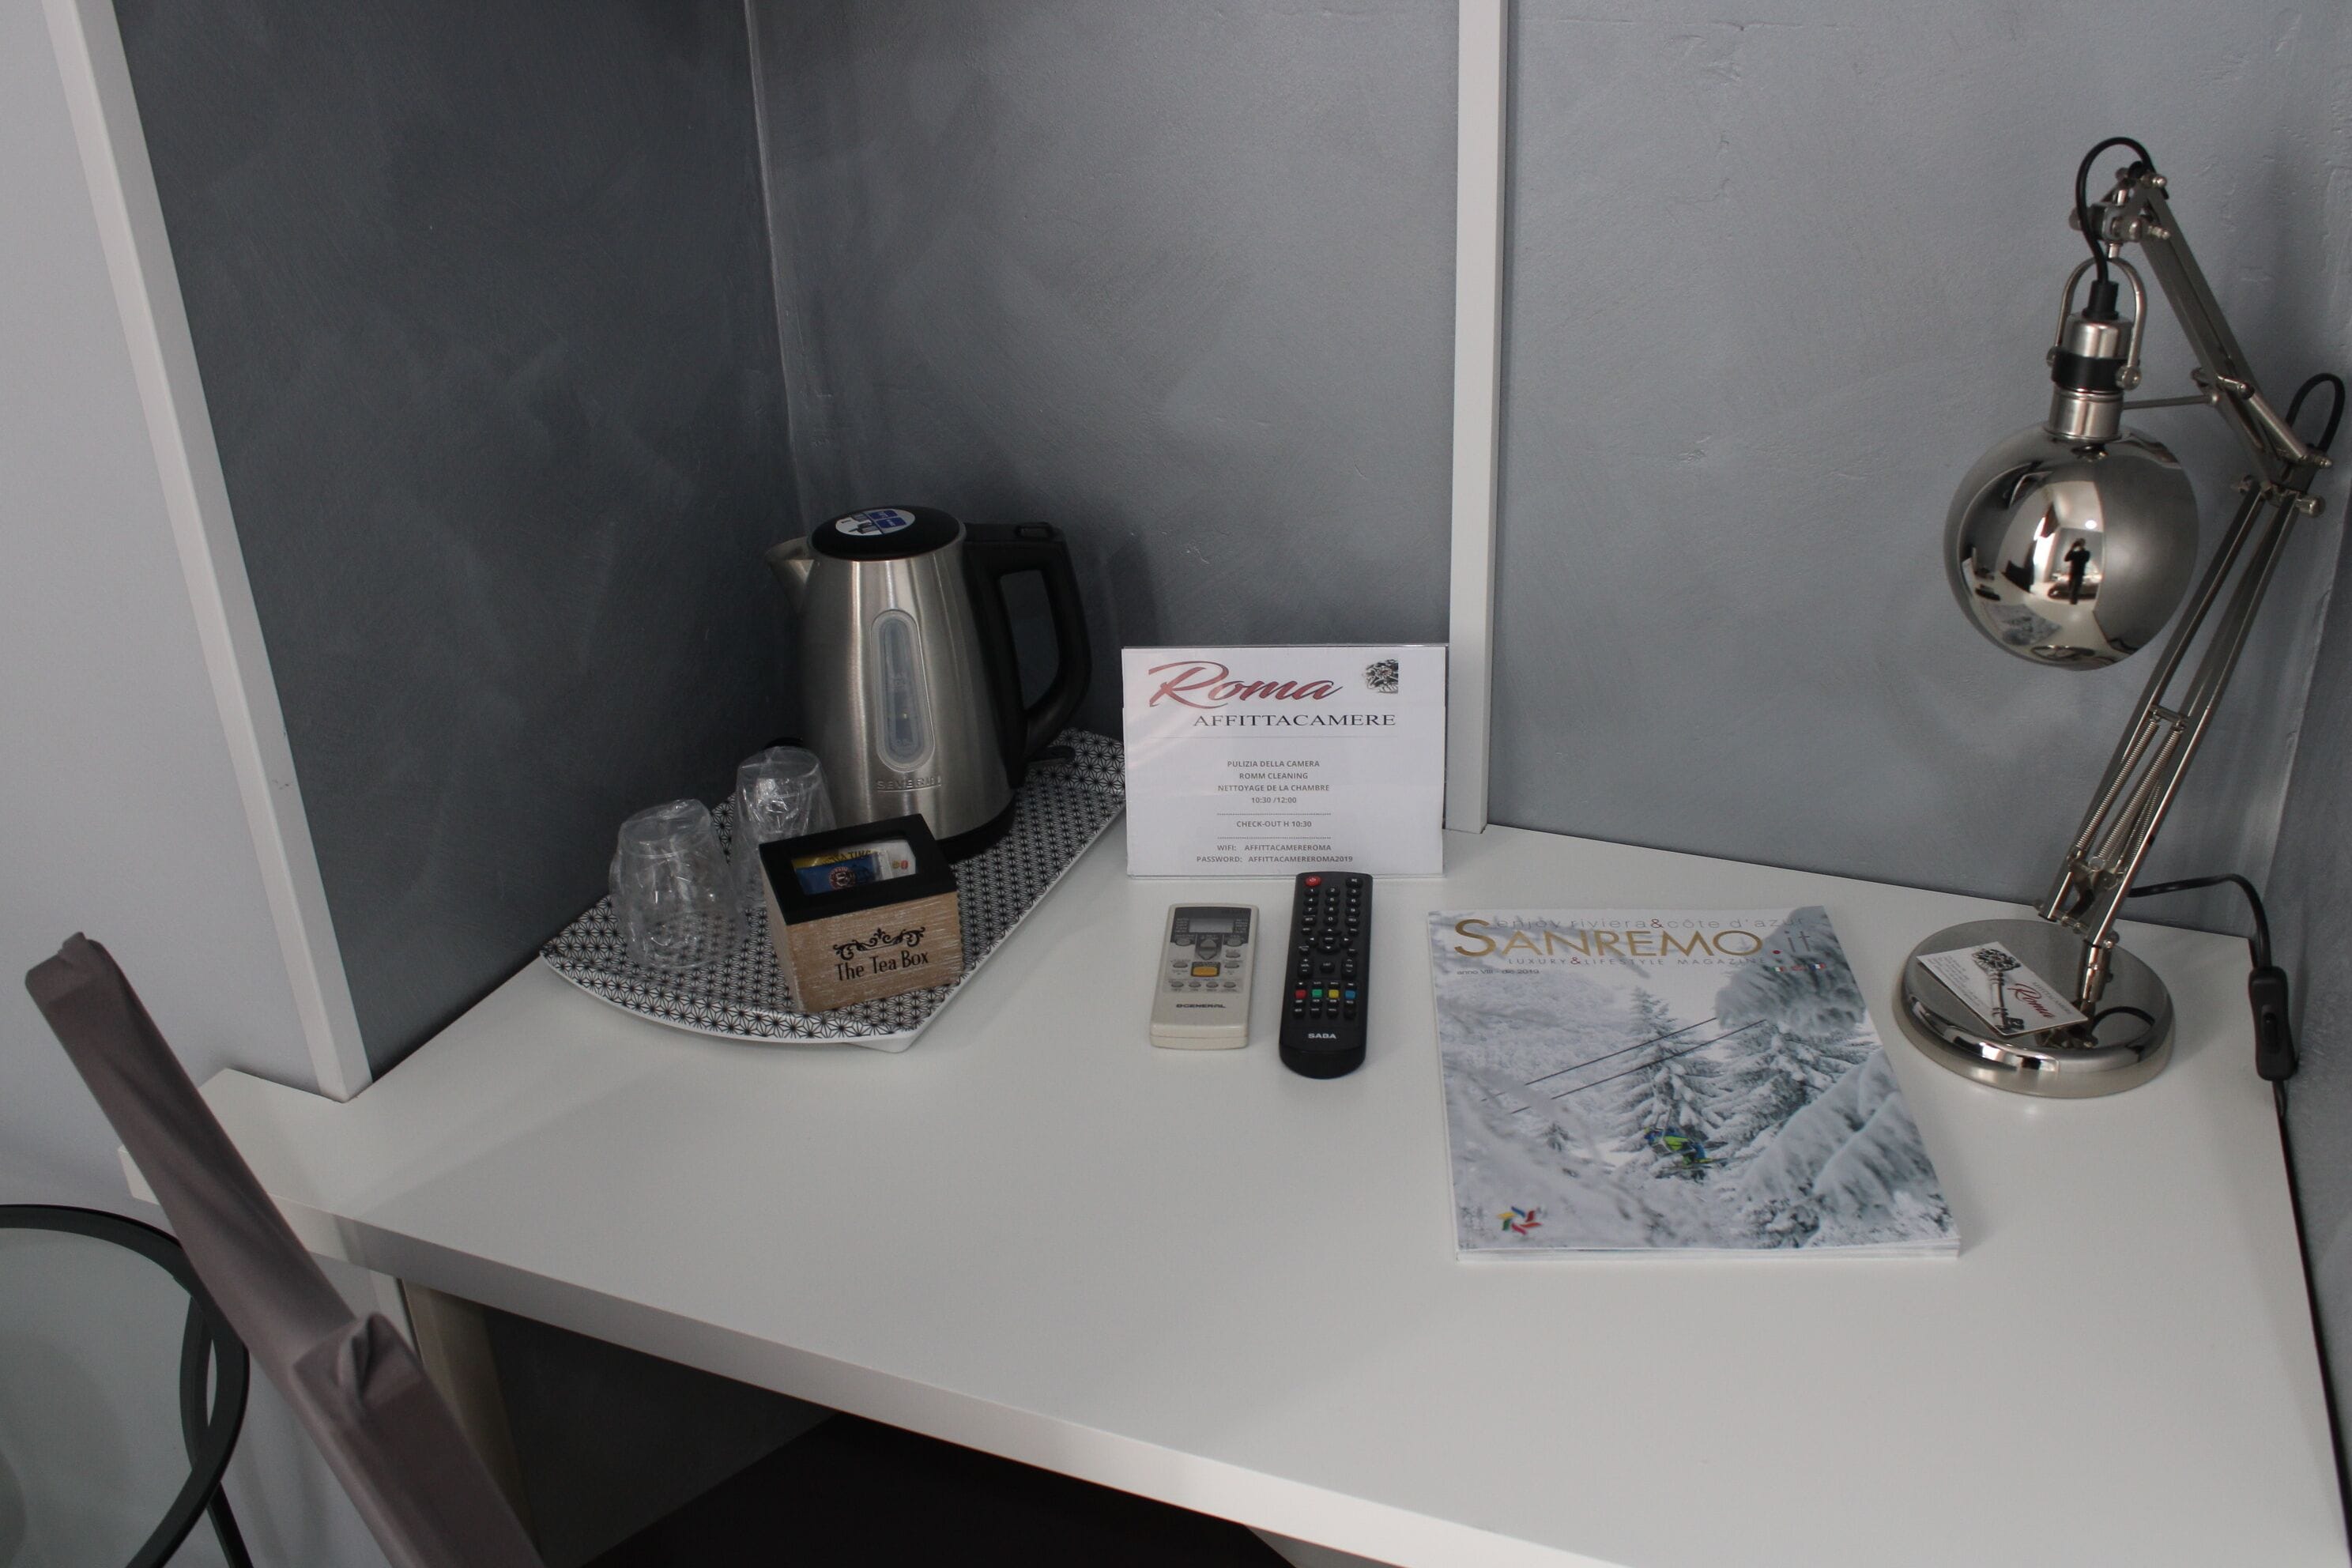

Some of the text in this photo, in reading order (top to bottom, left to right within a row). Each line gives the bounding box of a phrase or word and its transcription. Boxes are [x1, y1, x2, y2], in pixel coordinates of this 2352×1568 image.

[1148, 661, 1343, 709] Roma
[1193, 714, 1396, 726] AFFITTACAMERE
[835, 950, 929, 981] The Tea Box
[2007, 983, 2056, 1019] Roma
